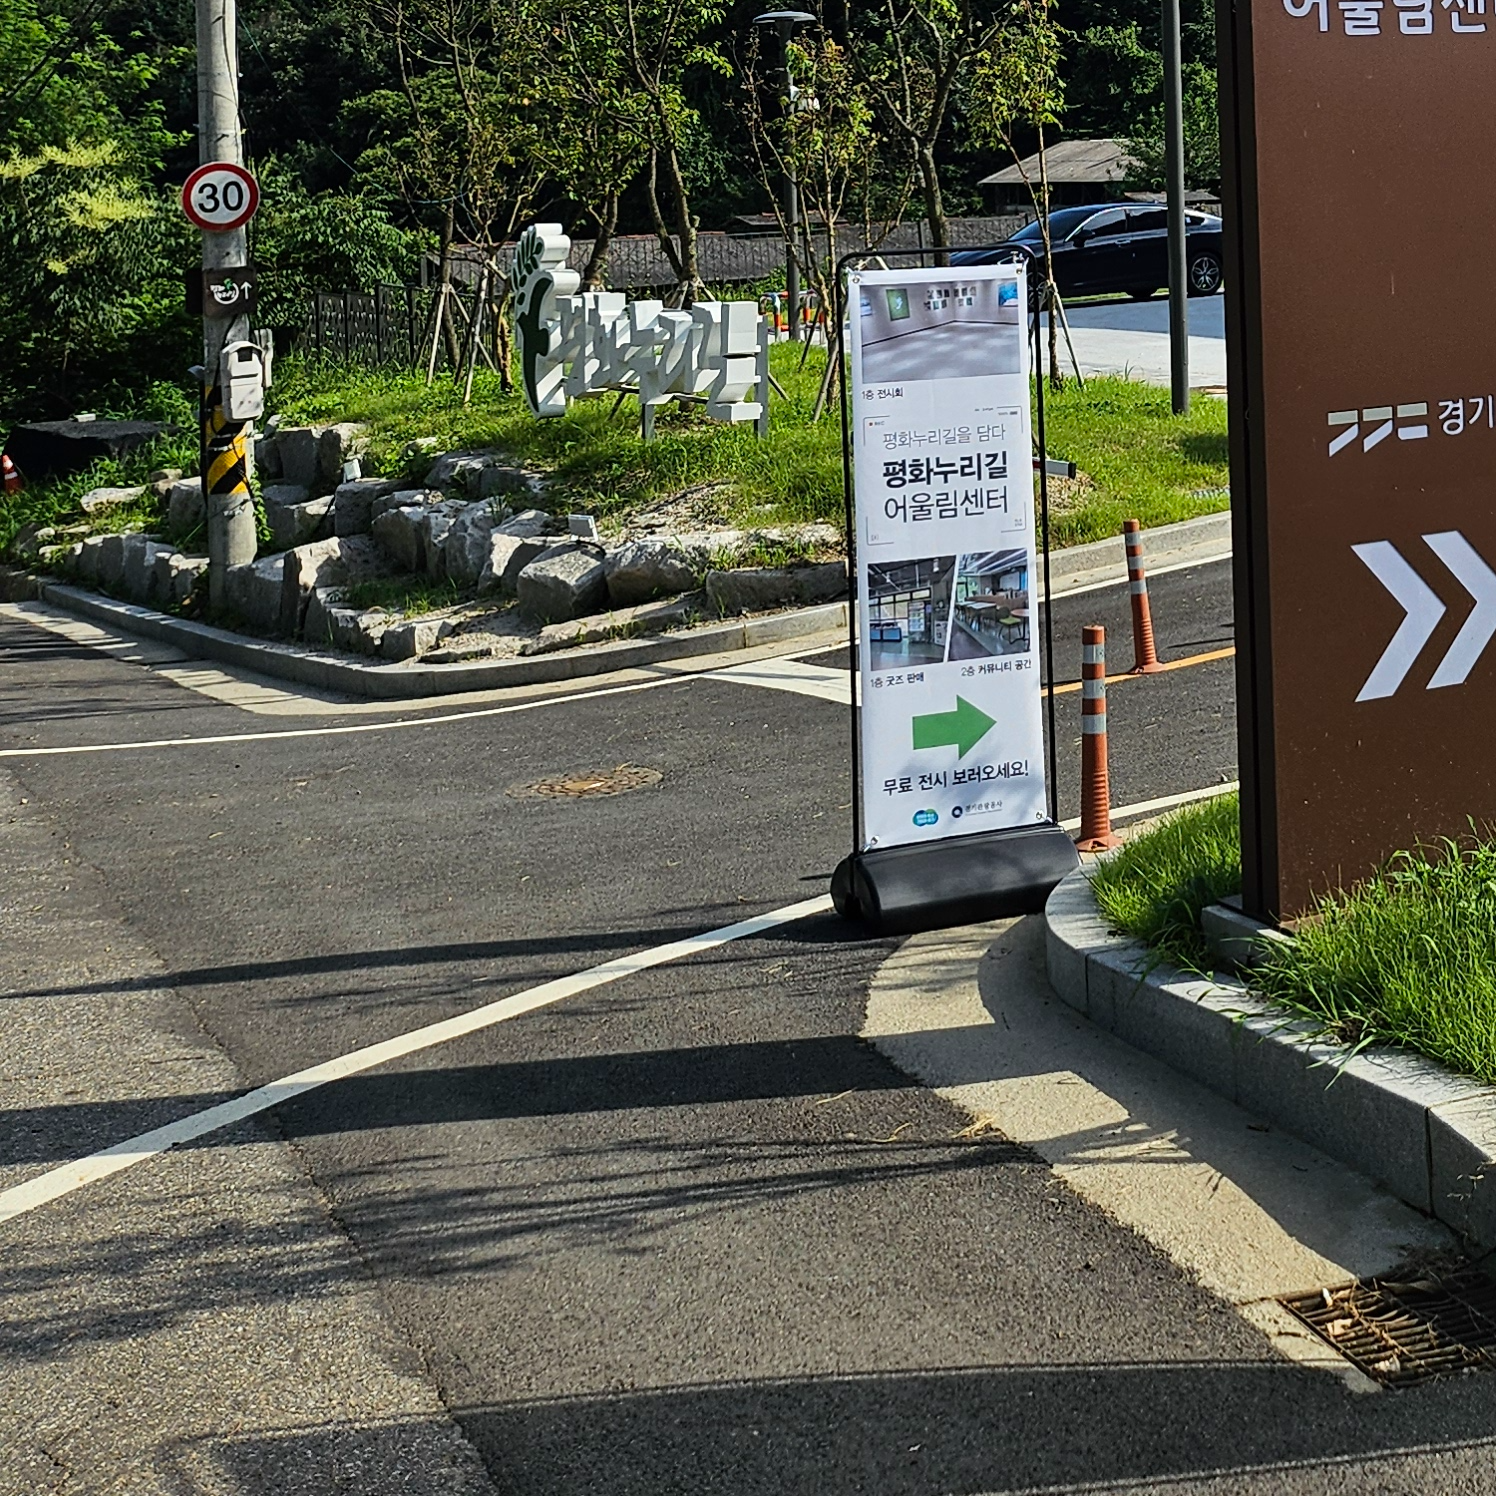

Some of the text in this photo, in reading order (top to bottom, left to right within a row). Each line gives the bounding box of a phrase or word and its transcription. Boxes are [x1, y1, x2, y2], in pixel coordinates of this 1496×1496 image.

[198, 181, 243, 213] 30
[862, 387, 904, 400] 1층 전시회
[883, 423, 1006, 450] 평화누리길을 담다
[883, 451, 1008, 488] 평화누리길
[884, 486, 1009, 523] 어울림센터
[871, 672, 925, 688] 1층 굿즈 판매
[961, 659, 1032, 677] 2층 커뮤니티 공간
[882, 760, 1030, 797] 무료 전시 보러오세요!
